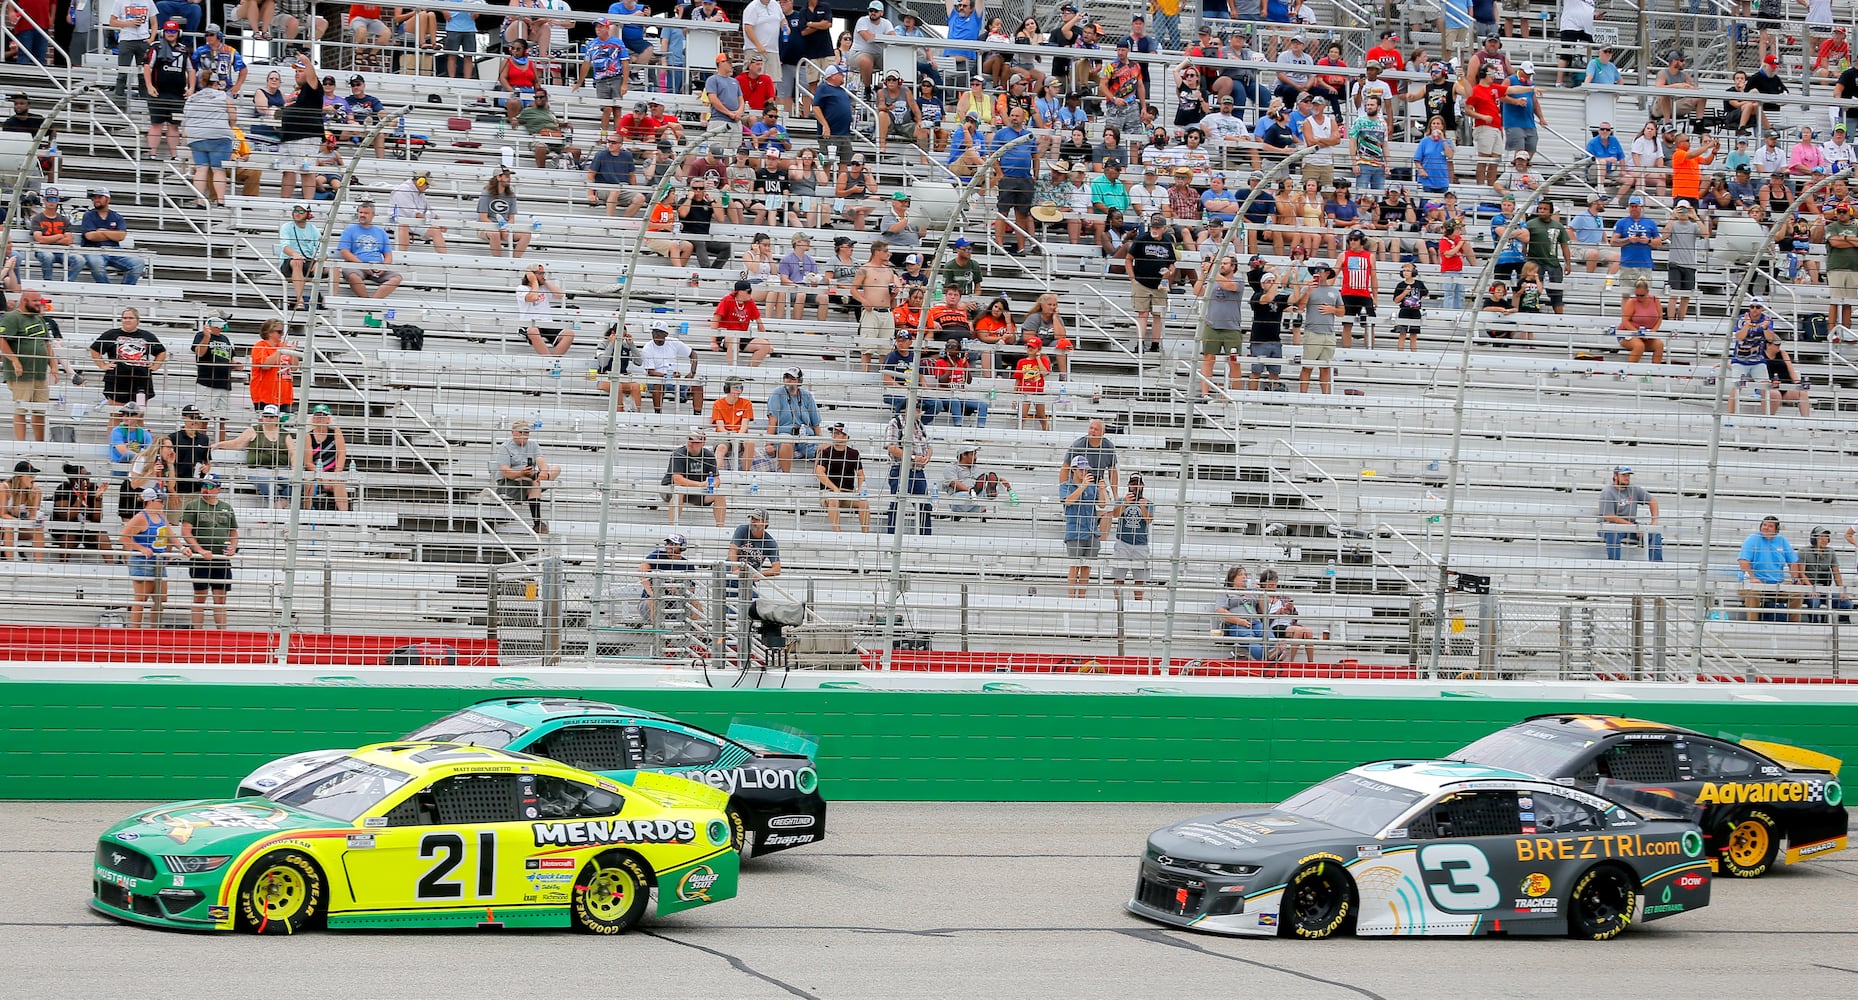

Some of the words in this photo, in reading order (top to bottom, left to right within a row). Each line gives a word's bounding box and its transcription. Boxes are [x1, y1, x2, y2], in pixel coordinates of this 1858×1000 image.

[765, 181, 781, 193] USA
[489, 199, 511, 214] G
[1761, 766, 1780, 774] DEX
[1750, 810, 1776, 827] EAGLE
[533, 819, 695, 847] MENARDS
[763, 834, 815, 847] Snap-on
[1298, 851, 1344, 864] GOODYEAR
[1516, 834, 1681, 861] BREZTRI.com
[1798, 840, 1837, 857] MENARDS
[97, 866, 138, 888] MUSTANG
[416, 832, 497, 901] 21
[622, 858, 648, 888] EAGLE
[1294, 864, 1322, 885] EAGL
[285, 854, 321, 917] GOODYEAR
[688, 873, 719, 883] QUAKER
[690, 881, 713, 889] STATE
[1419, 844, 1501, 911] 3
[1572, 870, 1597, 900] EAGLE
[242, 891, 260, 926] EAGLE
[1515, 898, 1559, 908] TRACKER
[1296, 901, 1349, 939] GOODYEAR
